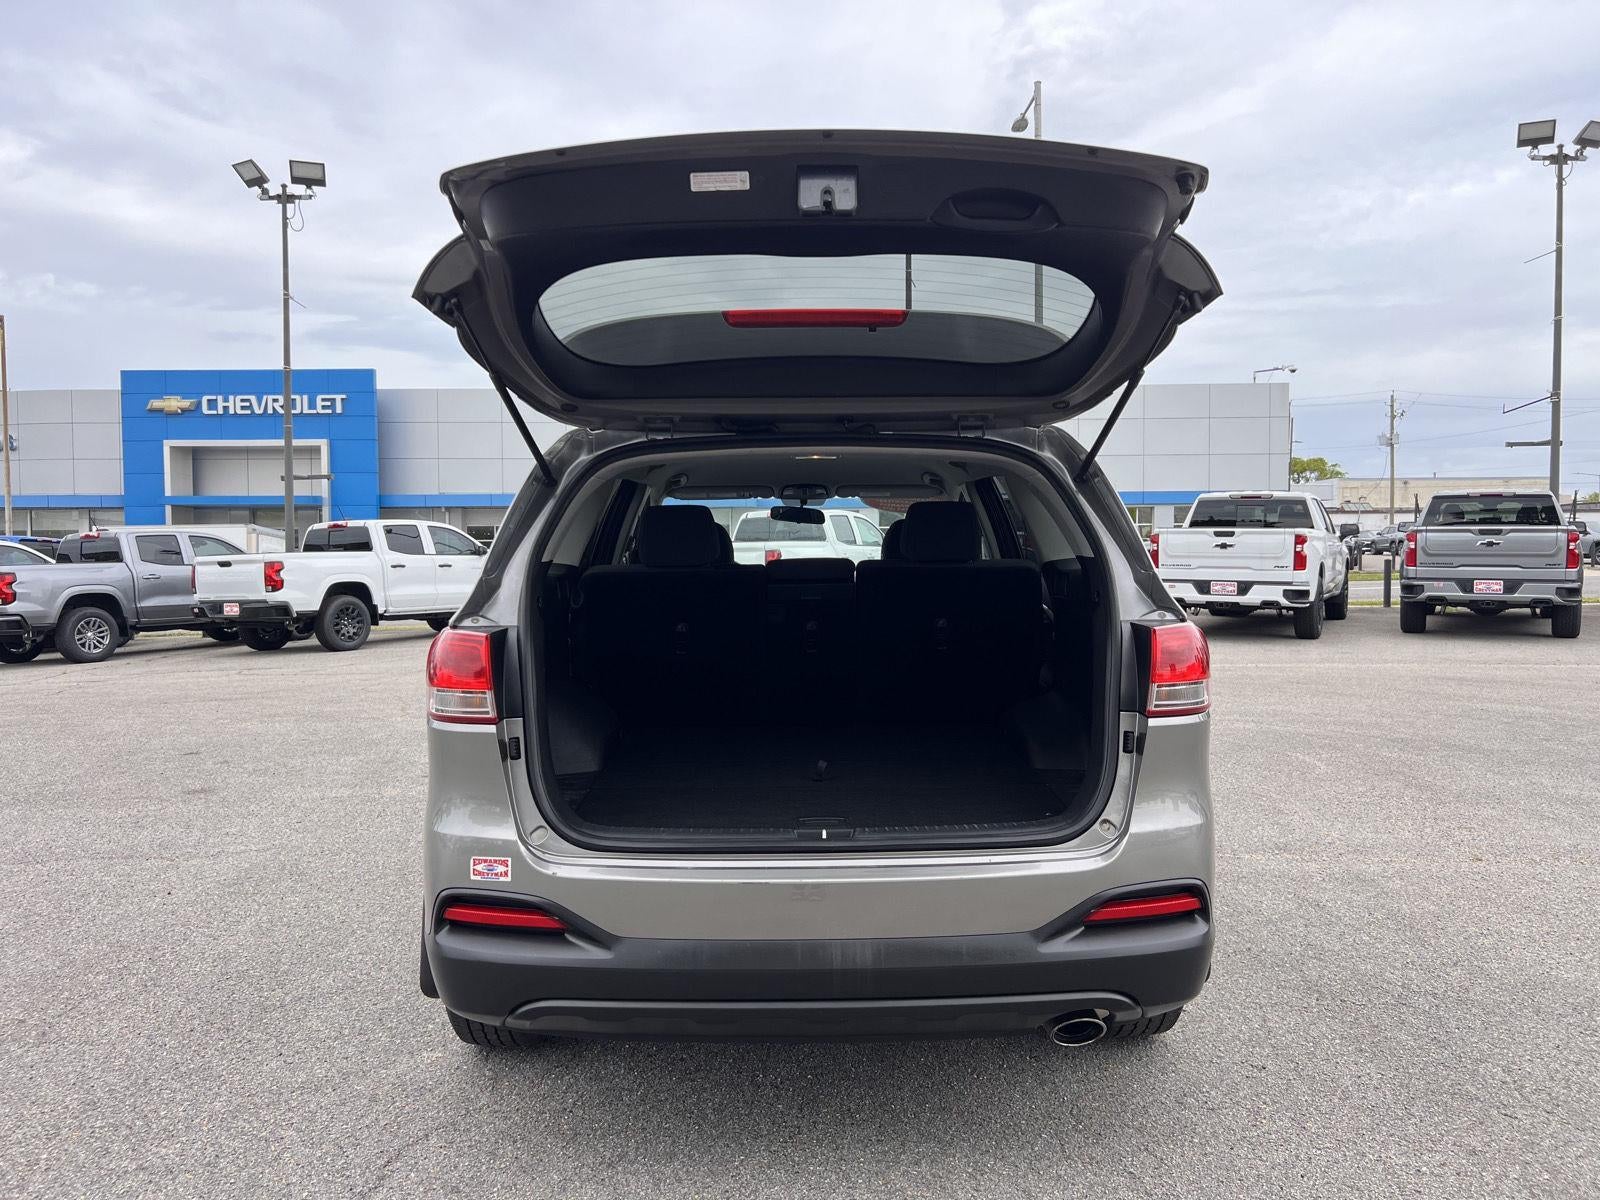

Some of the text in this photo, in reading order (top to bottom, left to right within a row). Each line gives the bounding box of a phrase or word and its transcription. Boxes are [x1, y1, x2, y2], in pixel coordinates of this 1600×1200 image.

[202, 395, 347, 415] CHEVROLET
[472, 858, 509, 867] EDWARDS
[472, 868, 509, 877] CHEVYMAN
